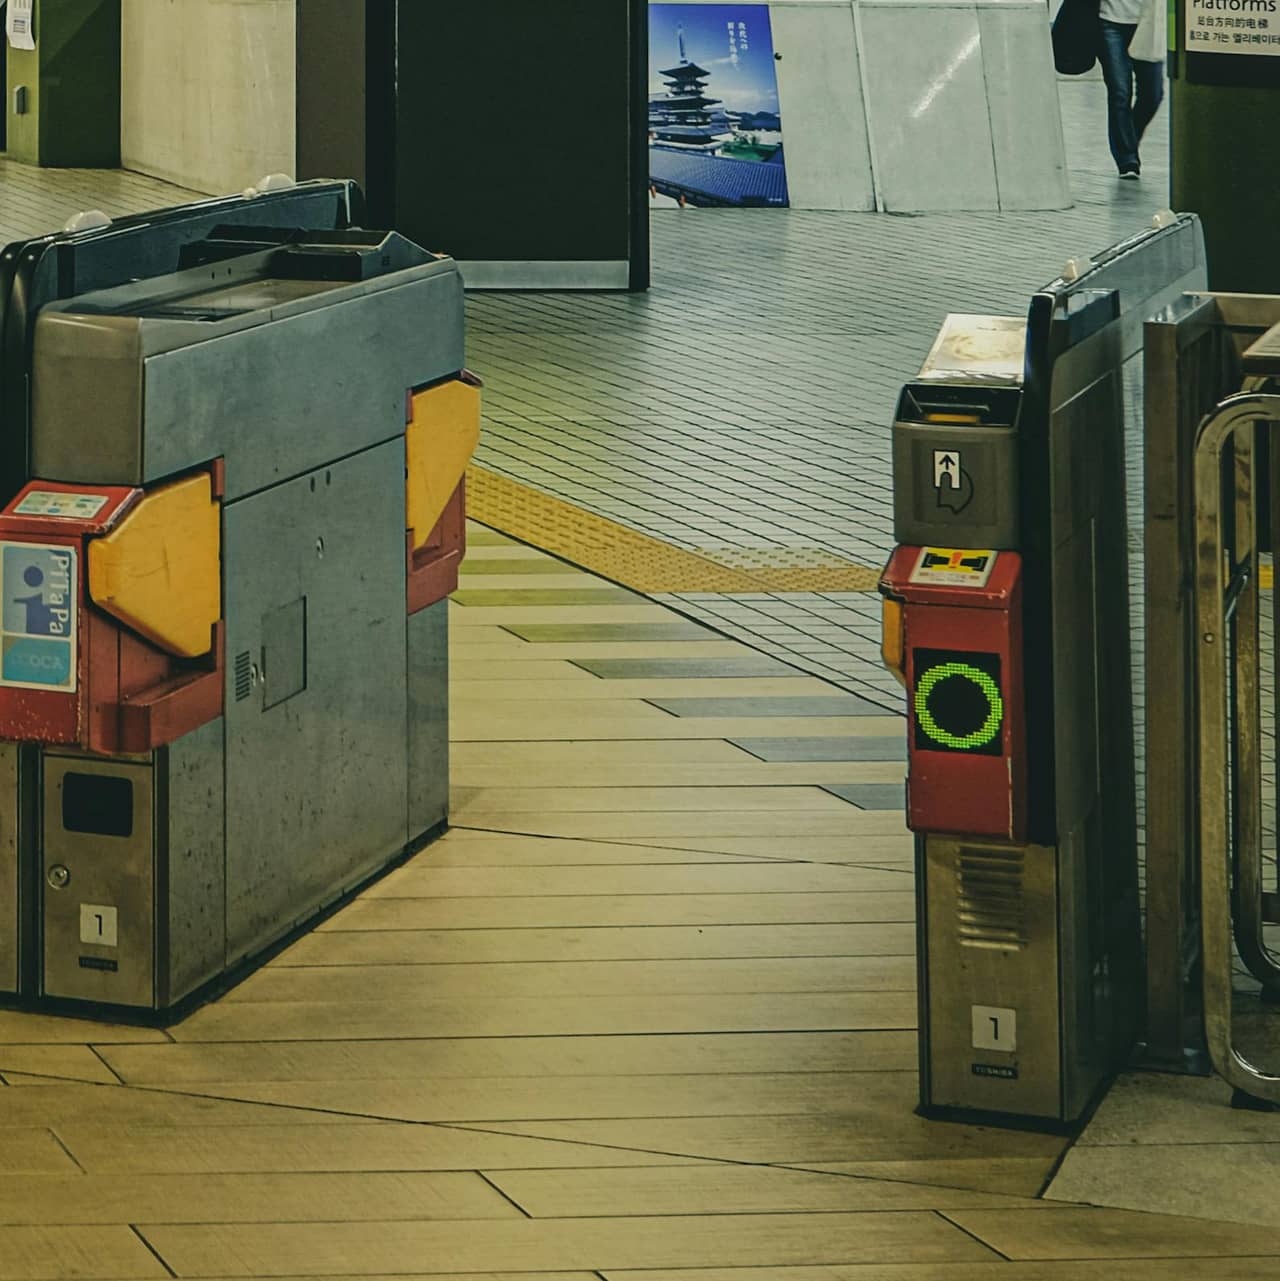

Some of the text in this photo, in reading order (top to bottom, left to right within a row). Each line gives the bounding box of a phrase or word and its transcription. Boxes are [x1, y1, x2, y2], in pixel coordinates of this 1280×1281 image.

[49, 555, 69, 634] PiTaPa
[95, 914, 102, 936] 1
[989, 1017, 998, 1040] 1
